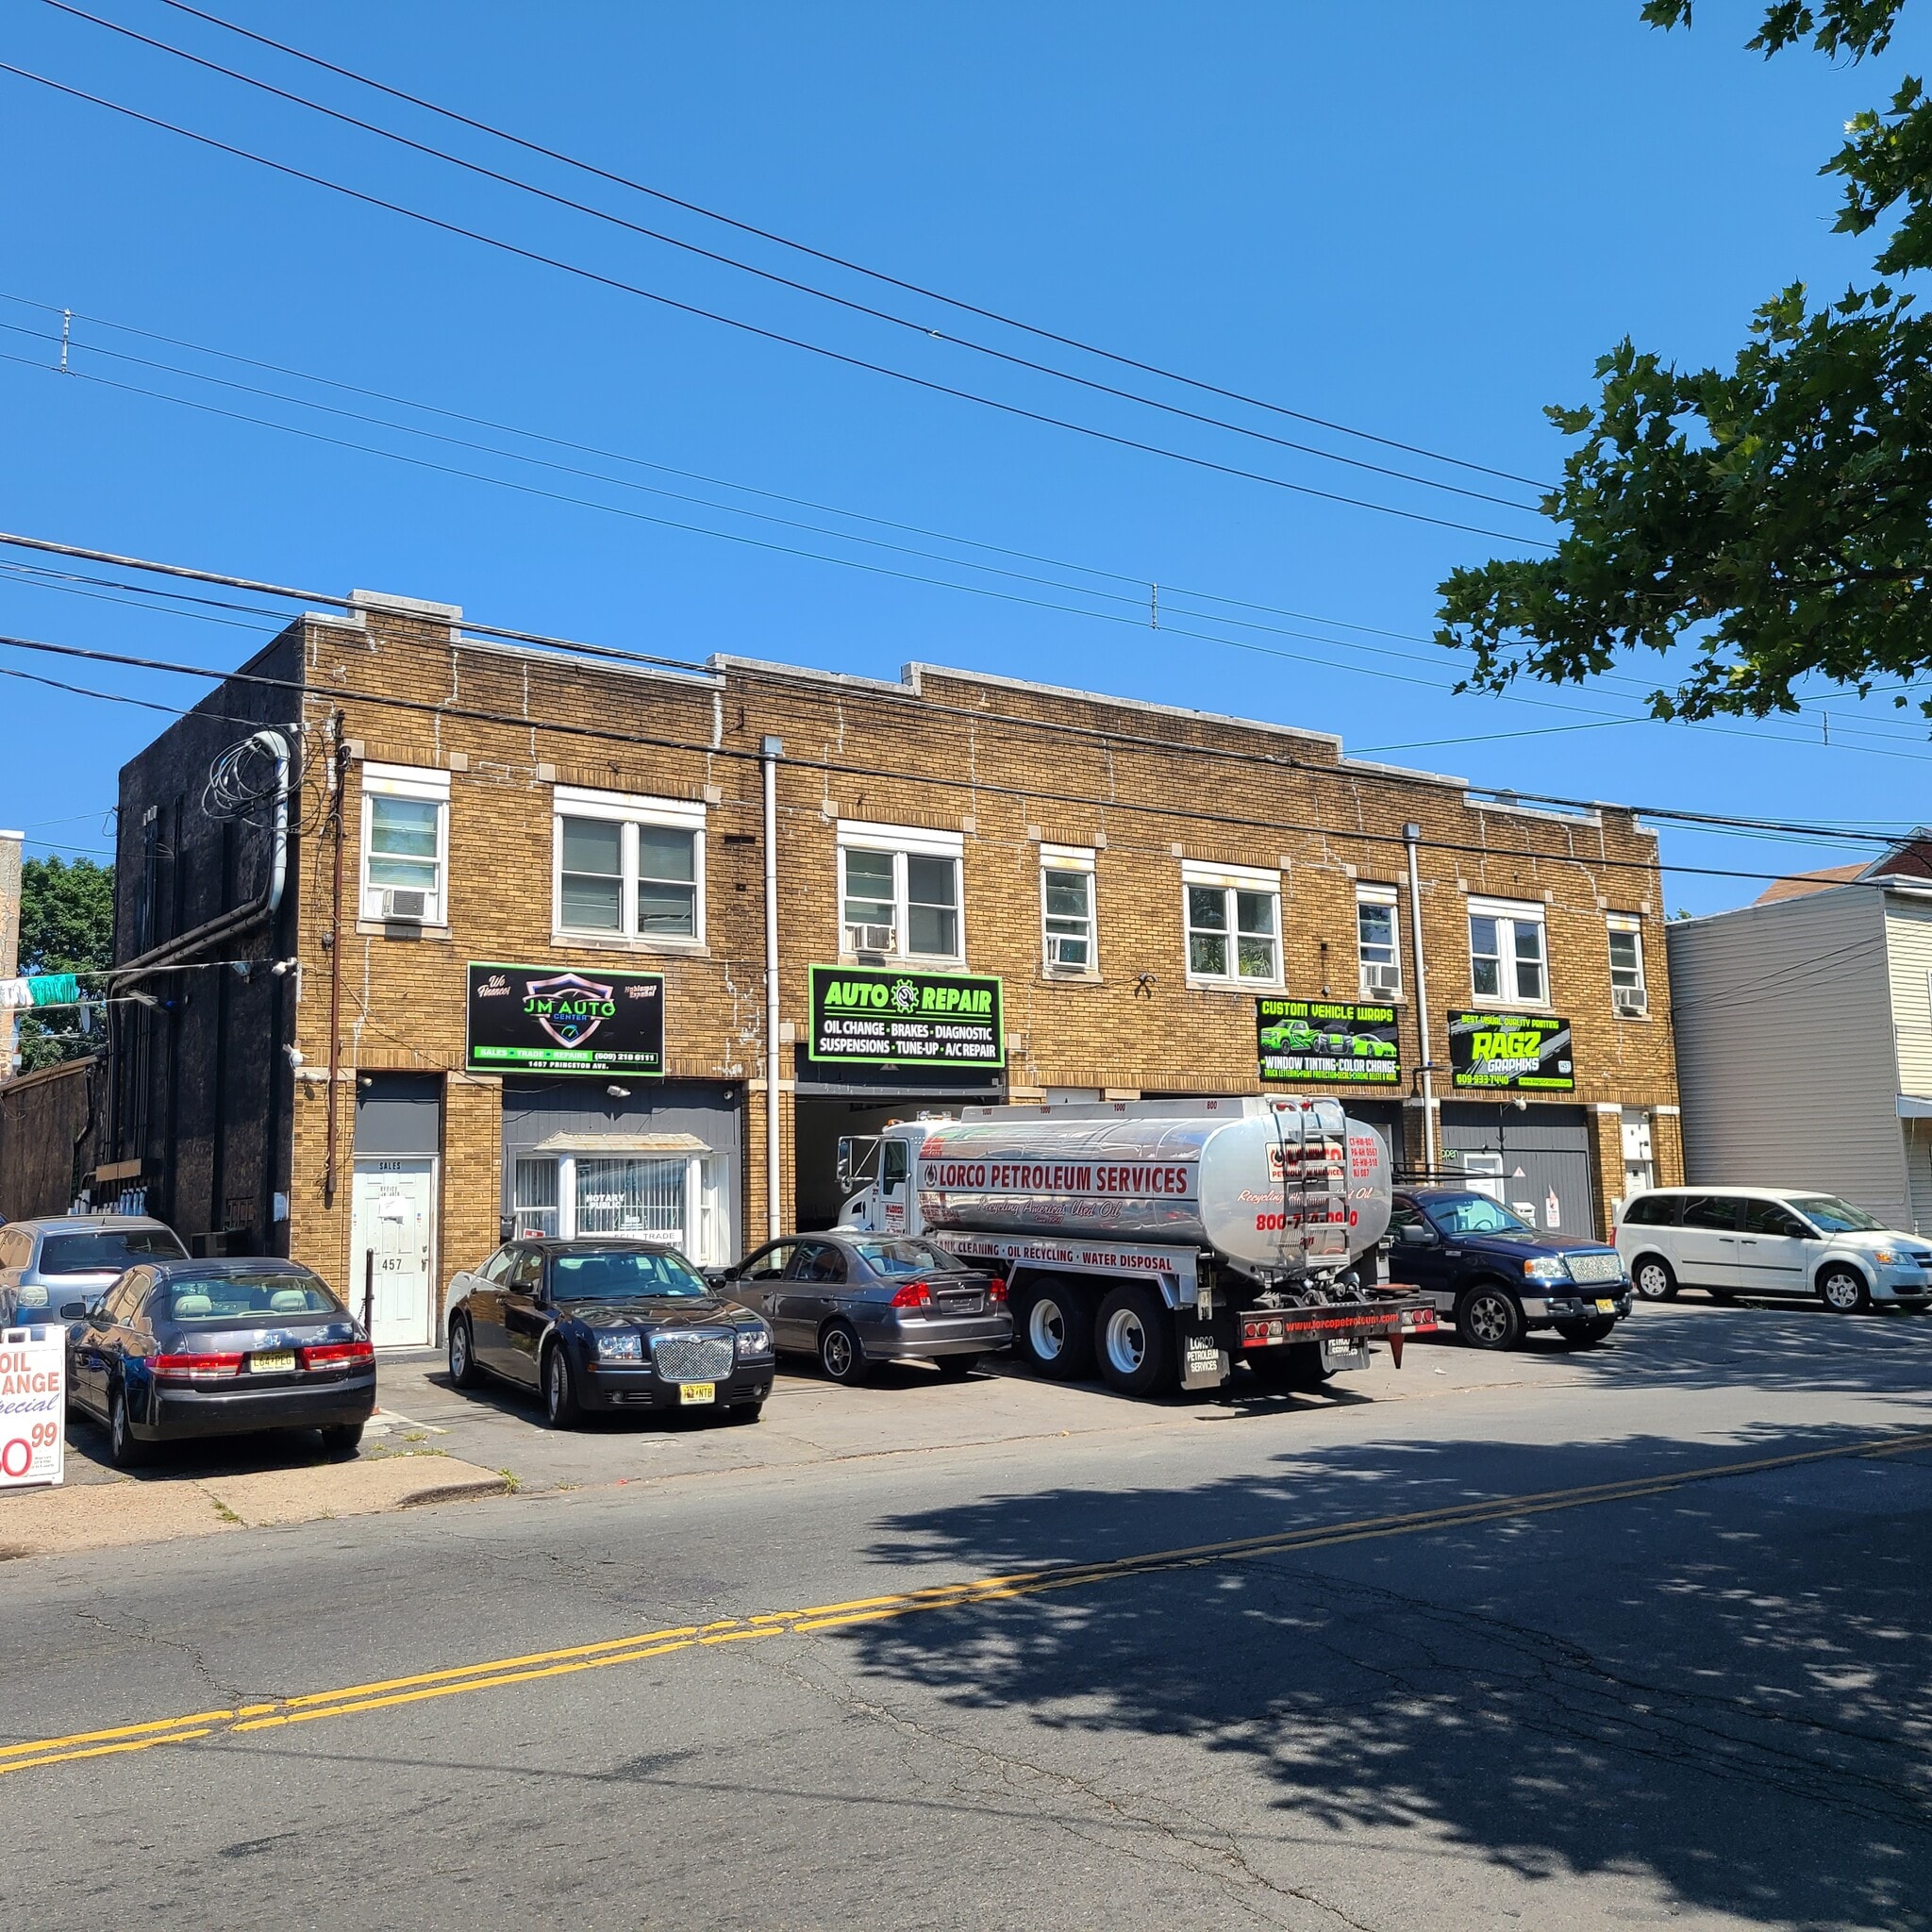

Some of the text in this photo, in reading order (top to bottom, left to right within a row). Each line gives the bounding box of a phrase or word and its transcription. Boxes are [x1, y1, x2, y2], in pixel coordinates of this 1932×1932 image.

[489, 974, 506, 988] We
[824, 982, 992, 1012] AUTO REPAIR
[524, 998, 616, 1017] JM AUTO
[1262, 1001, 1393, 1023] CUSTOM VEHICLE WRAPS
[824, 1020, 992, 1041] OIL CHANGE BRAKES DIAGNOSTIC
[1461, 1015, 1559, 1029] BEST VISUAL QUALITY PRINTING
[480, 1048, 508, 1057] SALES
[517, 1050, 544, 1058] TRADE
[554, 1051, 589, 1059] REPAIRS
[594, 1053, 616, 1061] (609)
[635, 1054, 655, 1062] 6111
[820, 1038, 996, 1058] SUSPENSIONS TUNE-UP A/C REPAIR
[1472, 1031, 1541, 1062] RAGZ
[1265, 1056, 1396, 1074] WINDOW TINTING COLOR CHANGE
[1488, 1058, 1540, 1072] GRAPHIXS
[1113, 1104, 1125, 1112] 1000
[940, 1164, 1188, 1193] LORCO PETROLEUM SERVICES
[586, 1193, 625, 1202] NOTARY
[1238, 1190, 1284, 1205] Recycling
[1357, 1187, 1374, 1200] Oil
[977, 1195, 1020, 1215] Recycling
[1071, 1200, 1094, 1217] Used
[1099, 1200, 1123, 1218] Oil
[1256, 1210, 1357, 1230] 800-74-090
[382, 1258, 402, 1271] 457
[958, 1244, 999, 1256] CLEANING
[1008, 1246, 1022, 1257] OIL
[1024, 1247, 1074, 1262] RECYCLING
[1082, 1252, 1117, 1266] WATER
[1120, 1255, 1173, 1271] DISPOSAL
[1190, 1336, 1214, 1350] LORCO
[0, 1352, 31, 1374] OIL
[1188, 1349, 1219, 1362] PETROLEUM
[1191, 1360, 1218, 1373] SERVICES
[32, 1422, 58, 1448] 99
